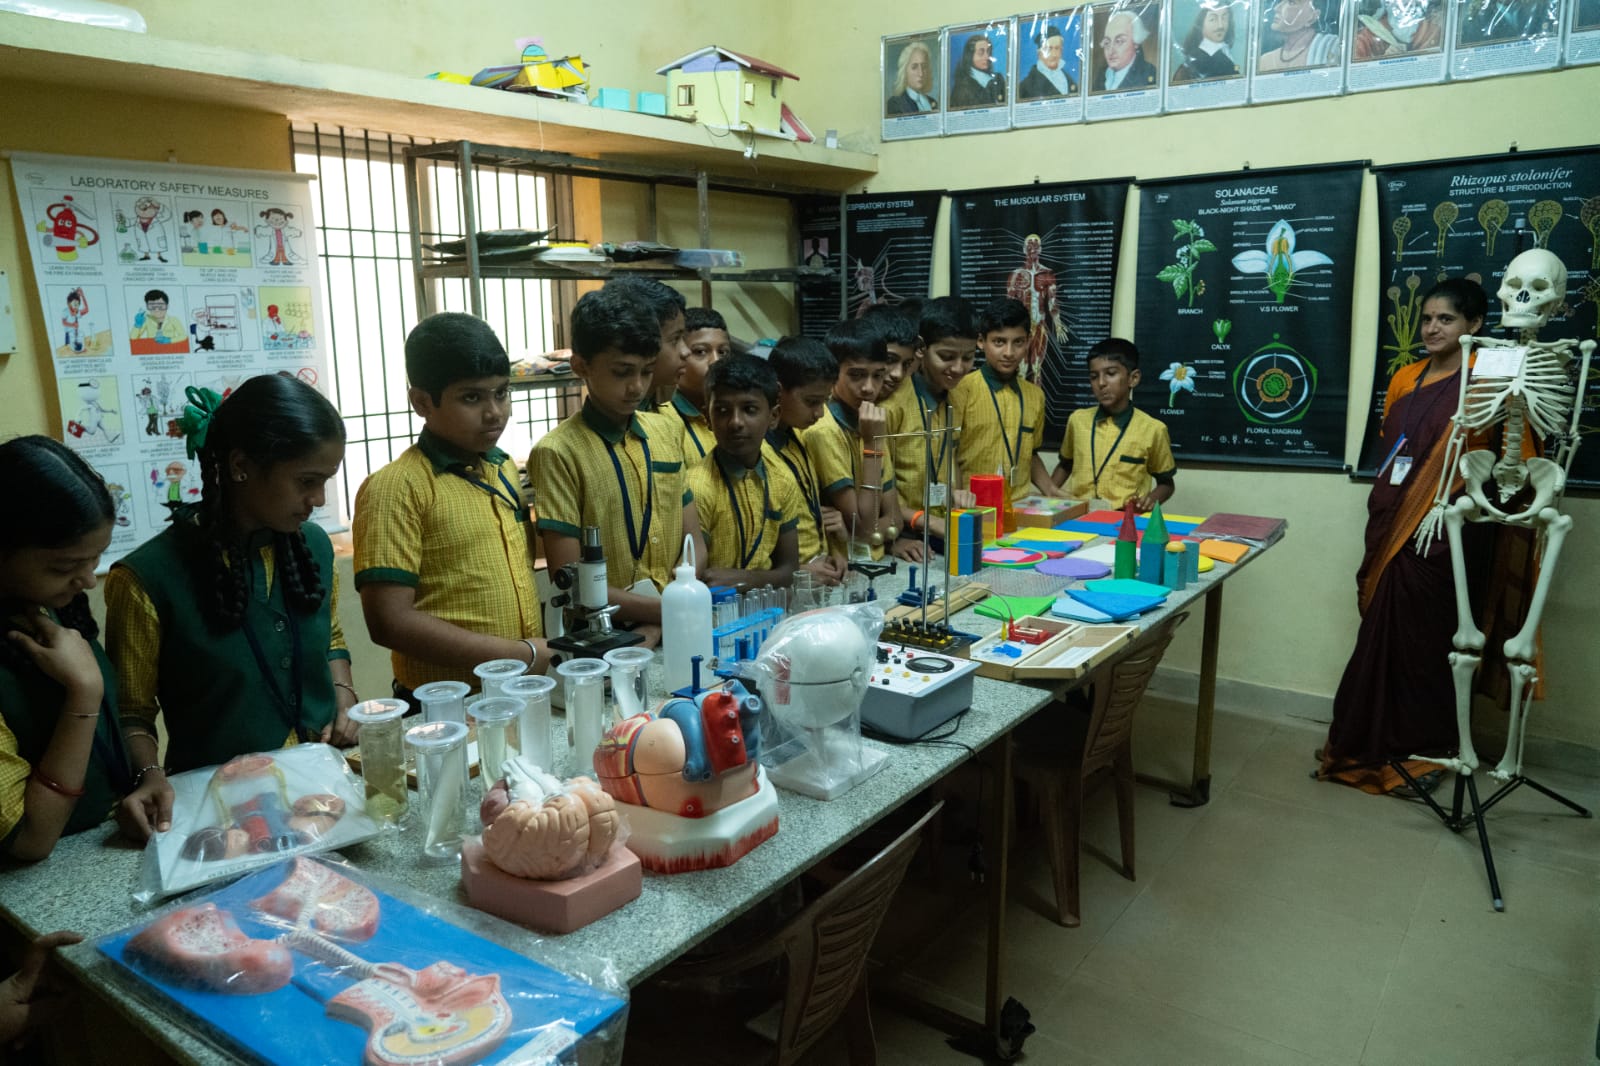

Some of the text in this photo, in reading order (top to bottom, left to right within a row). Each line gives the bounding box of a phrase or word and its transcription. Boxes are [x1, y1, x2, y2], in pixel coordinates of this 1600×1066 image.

[1450, 167, 1573, 188] Rhizopus stolonifer
[70, 176, 270, 200] LABORATORY SAFETY MEASURES
[1215, 186, 1279, 199] SOLANACEAE
[1449, 182, 1572, 197] STRUCTURE & REPRODUCTION
[847, 200, 914, 211] ESPIRATORY SYSTEM
[994, 193, 1086, 207] THE MUSCULAR SYSTEM
[1240, 205, 1262, 213] SHADE
